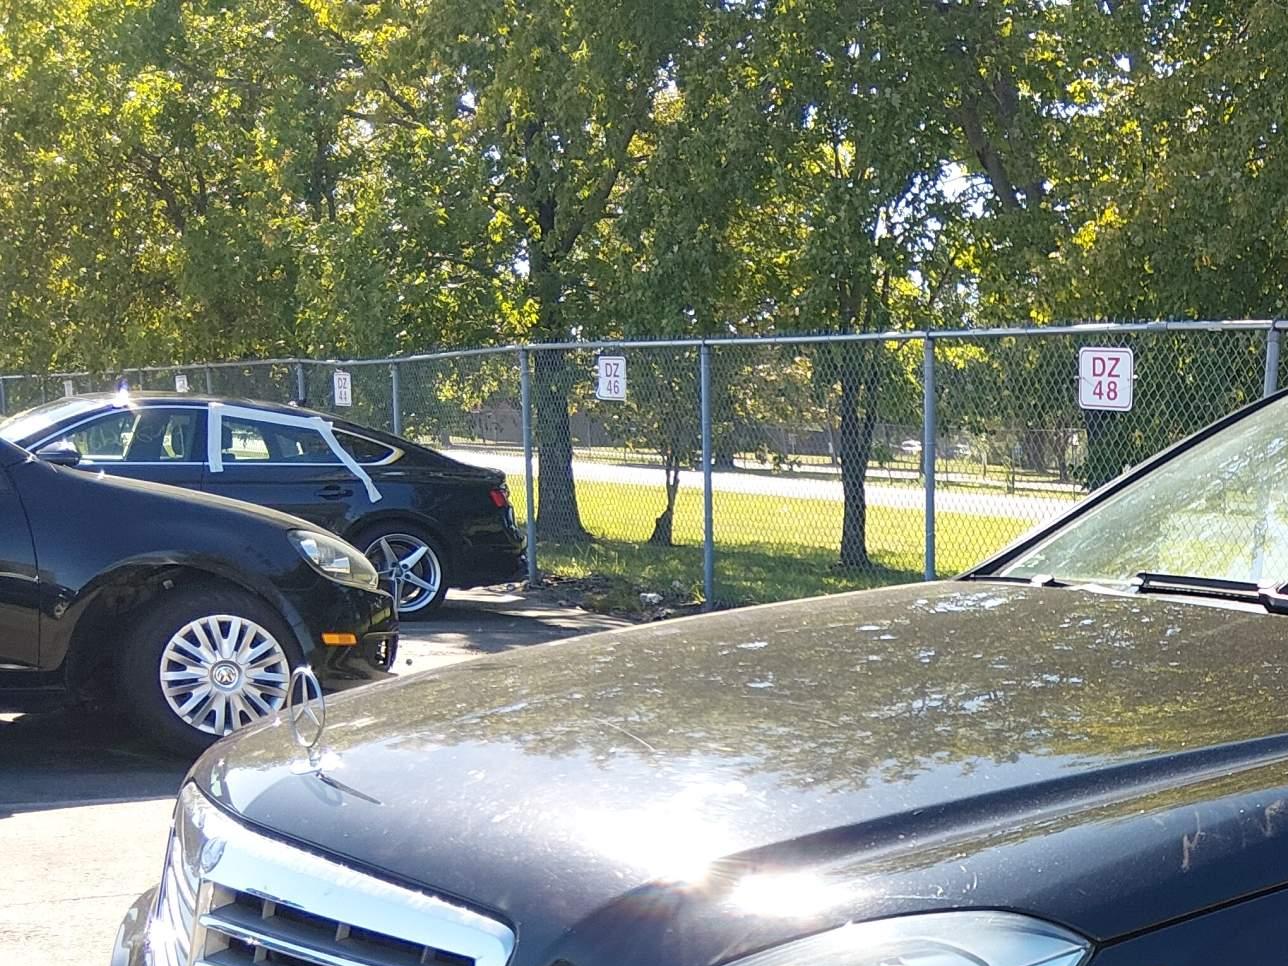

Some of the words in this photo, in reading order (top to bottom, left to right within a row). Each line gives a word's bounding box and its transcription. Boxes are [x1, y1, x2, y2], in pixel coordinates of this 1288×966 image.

[605, 362, 620, 378] DZ
[1092, 356, 1121, 378] DZ
[607, 379, 620, 394] 46
[1092, 380, 1118, 401] 48
